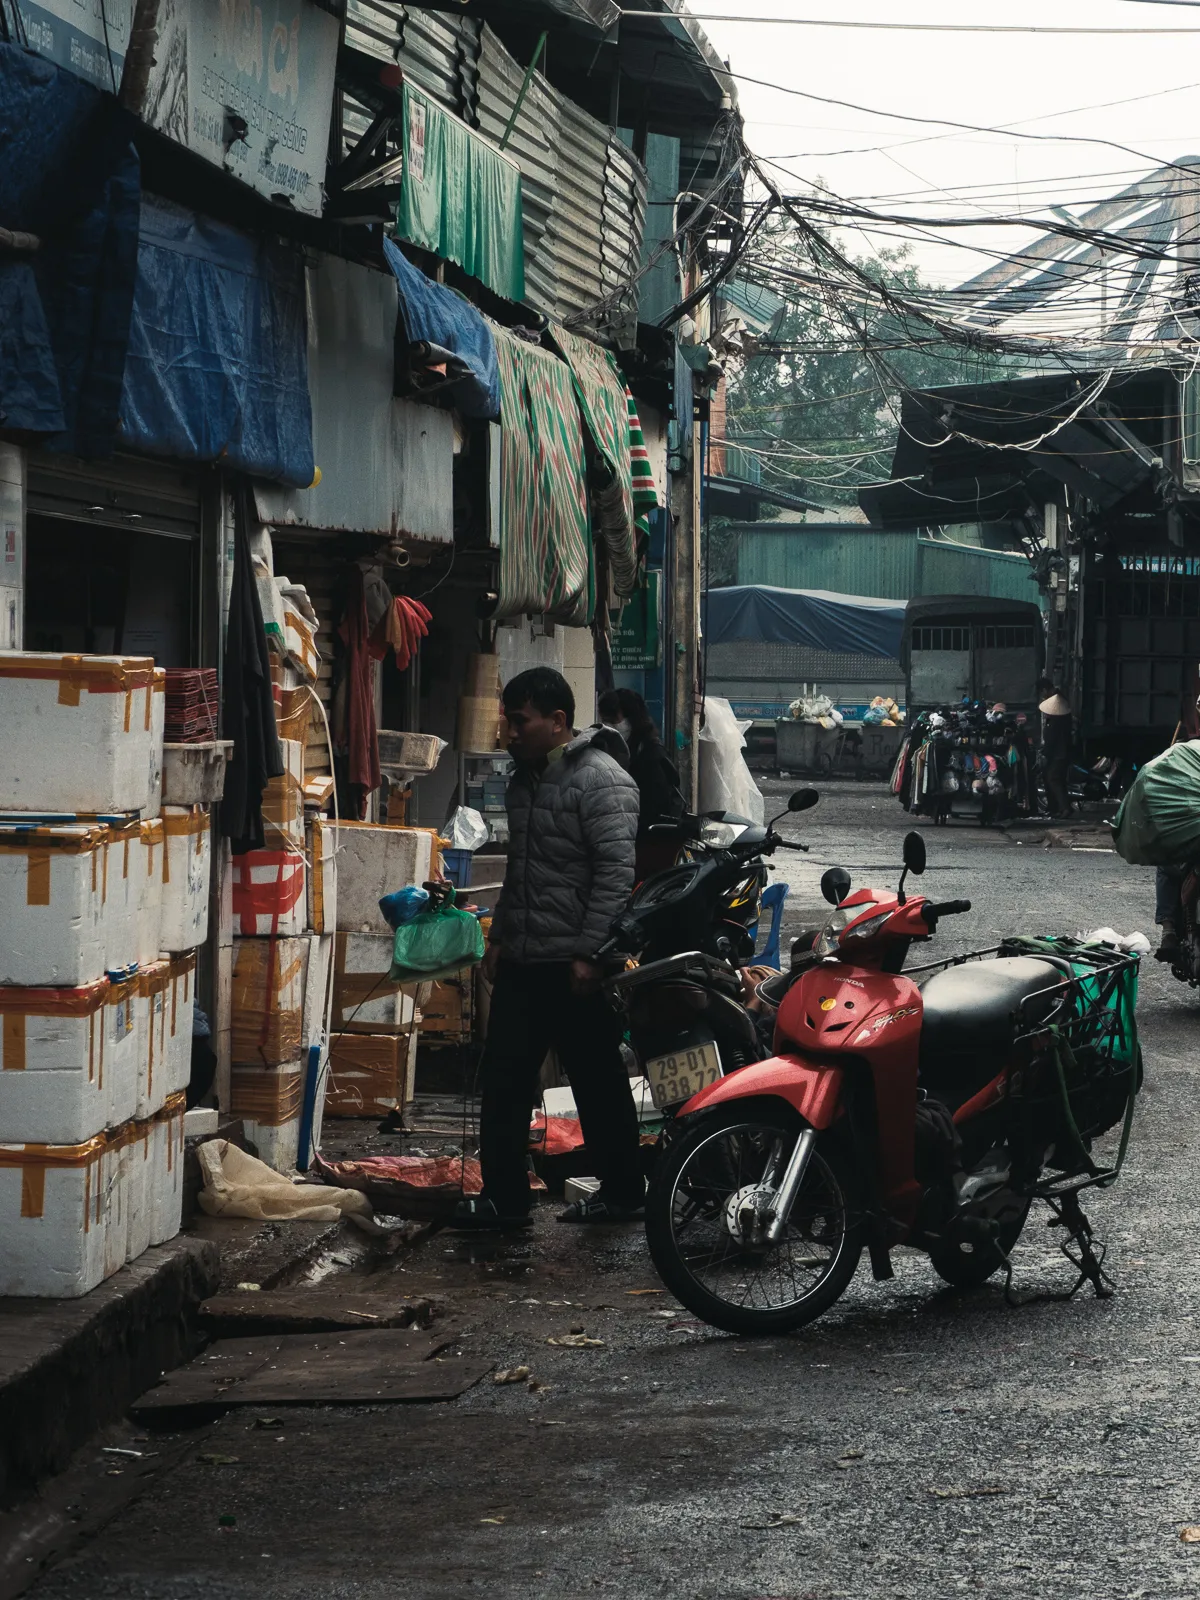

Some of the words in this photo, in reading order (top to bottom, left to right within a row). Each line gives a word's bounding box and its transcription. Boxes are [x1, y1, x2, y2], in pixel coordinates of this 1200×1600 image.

[281, 108, 309, 154] SỐNG
[834, 977, 865, 988] HONDA
[656, 1047, 708, 1080] 29-D1
